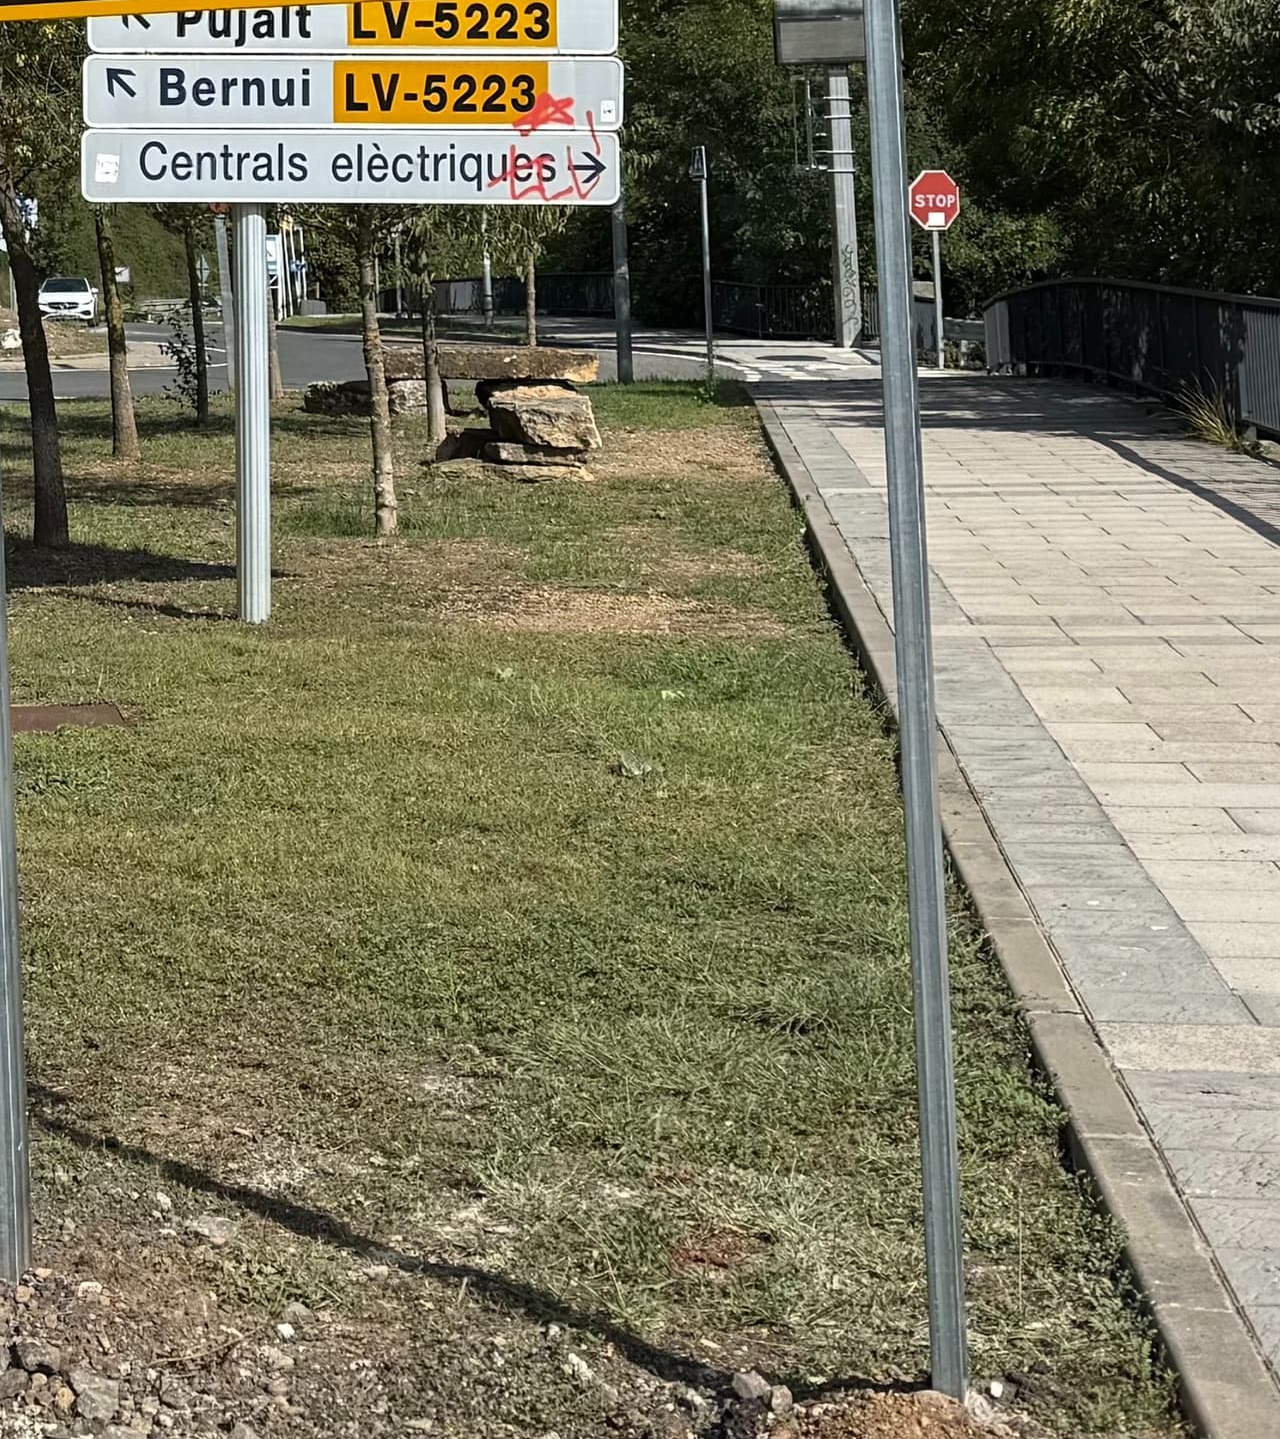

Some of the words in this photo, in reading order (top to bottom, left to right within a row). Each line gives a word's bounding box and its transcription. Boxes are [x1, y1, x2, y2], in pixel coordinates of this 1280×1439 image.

[177, 5, 310, 47] Pujalt
[354, 1, 549, 39] LV-5223
[160, 68, 309, 106] Bernui
[346, 74, 535, 112] LV-5223
[140, 142, 307, 181] Centrals
[915, 193, 956, 209] STOP
